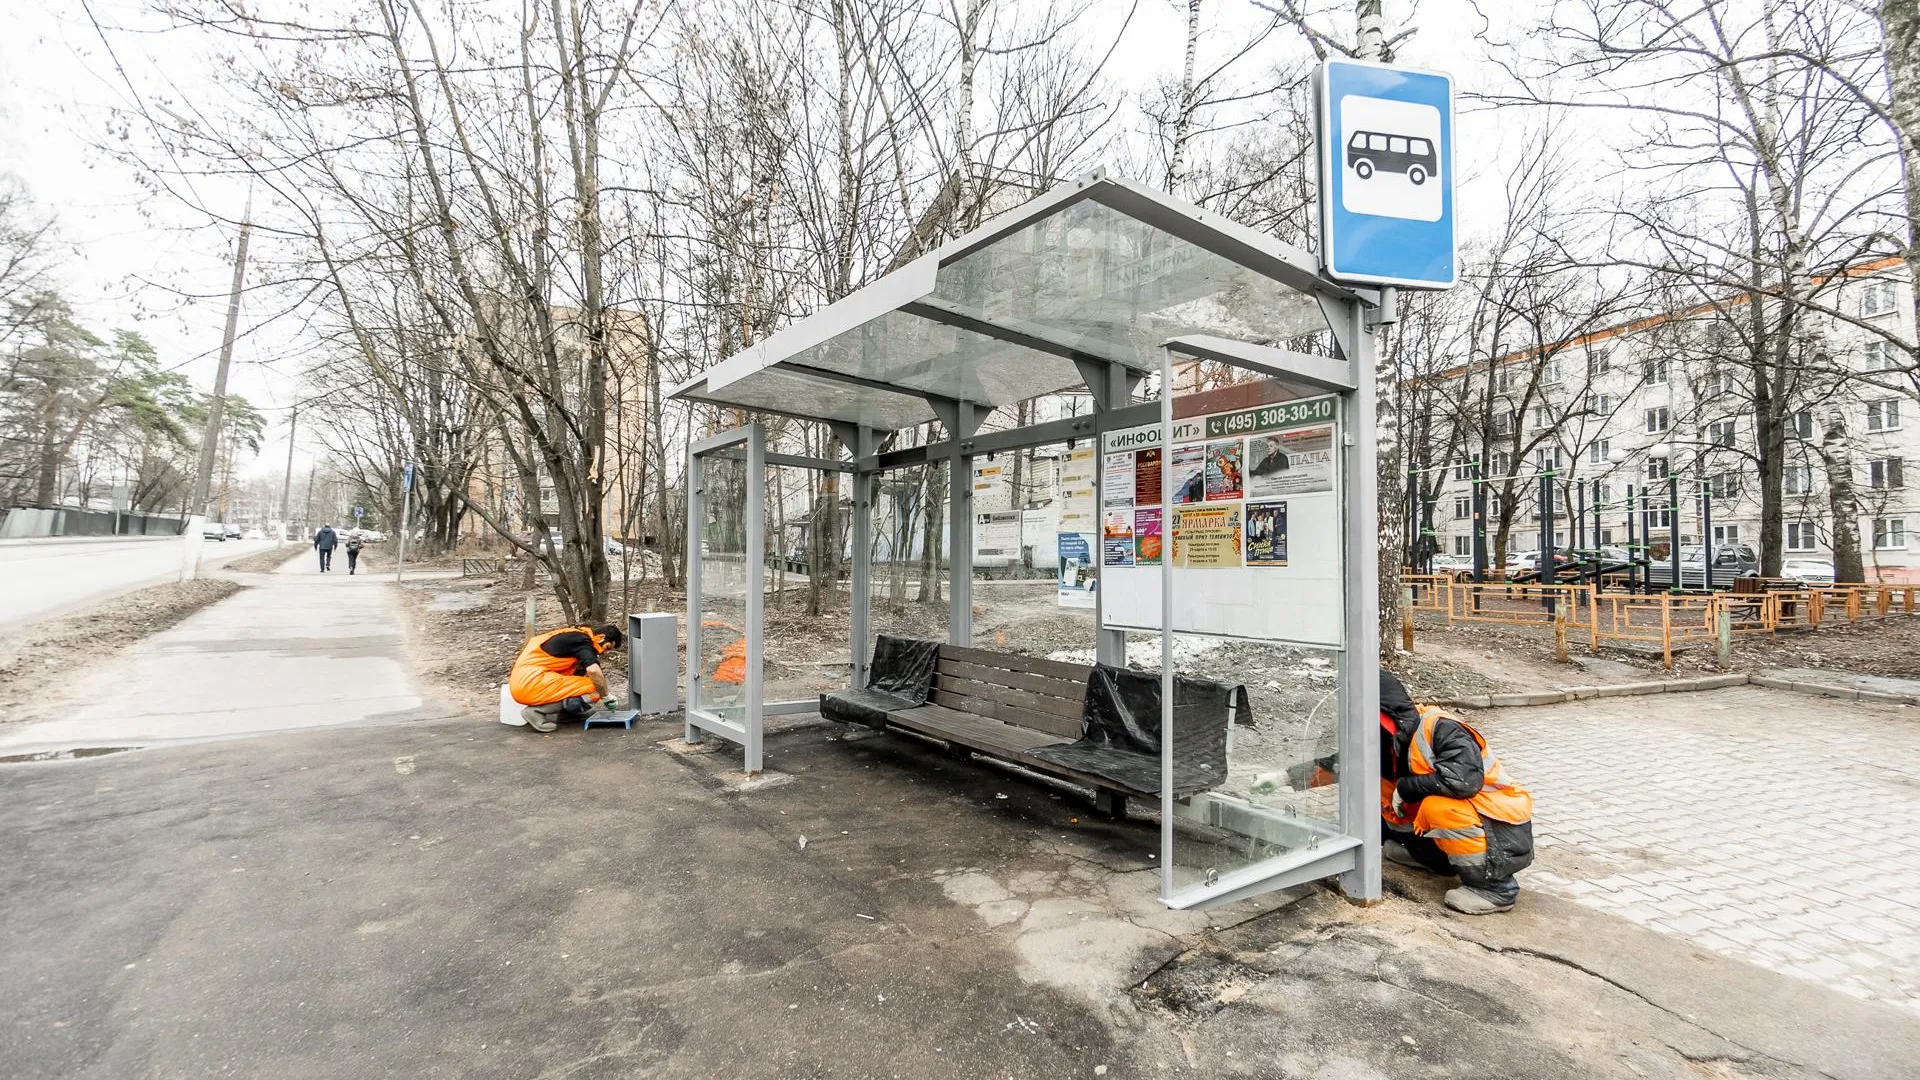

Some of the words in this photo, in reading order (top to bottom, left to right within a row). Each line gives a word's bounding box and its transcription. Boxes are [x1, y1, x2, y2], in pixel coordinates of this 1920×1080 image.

[1224, 412, 1257, 435] (495)
[1261, 400, 1331, 426] 308-30-10
[1290, 451, 1331, 466] ПАПА
[1206, 462, 1217, 470] 31
[1172, 515, 1181, 525] 27
[1182, 516, 1226, 529] ЯРМАРКА
